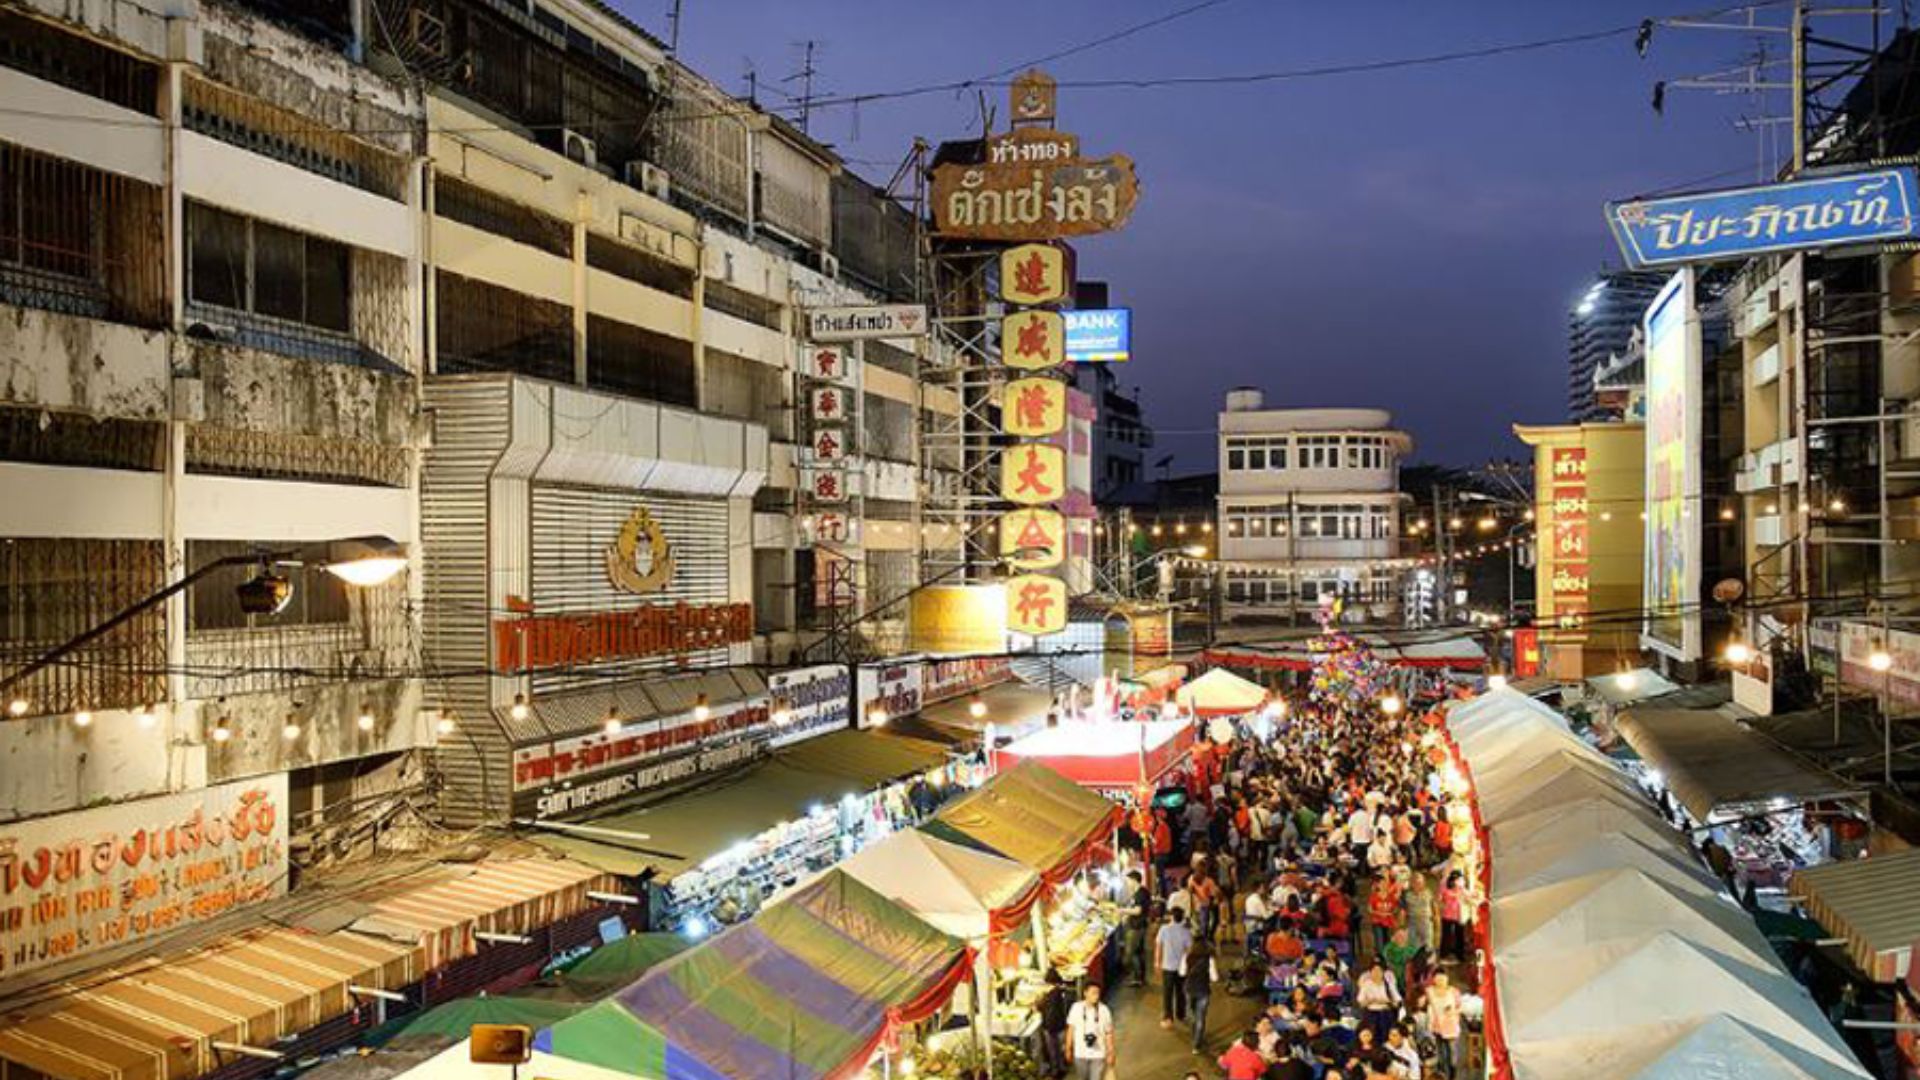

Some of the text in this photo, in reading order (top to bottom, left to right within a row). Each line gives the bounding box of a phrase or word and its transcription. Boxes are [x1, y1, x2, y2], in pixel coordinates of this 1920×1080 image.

[992, 139, 1071, 163] ห้างทอง
[1066, 313, 1119, 328] BANK
